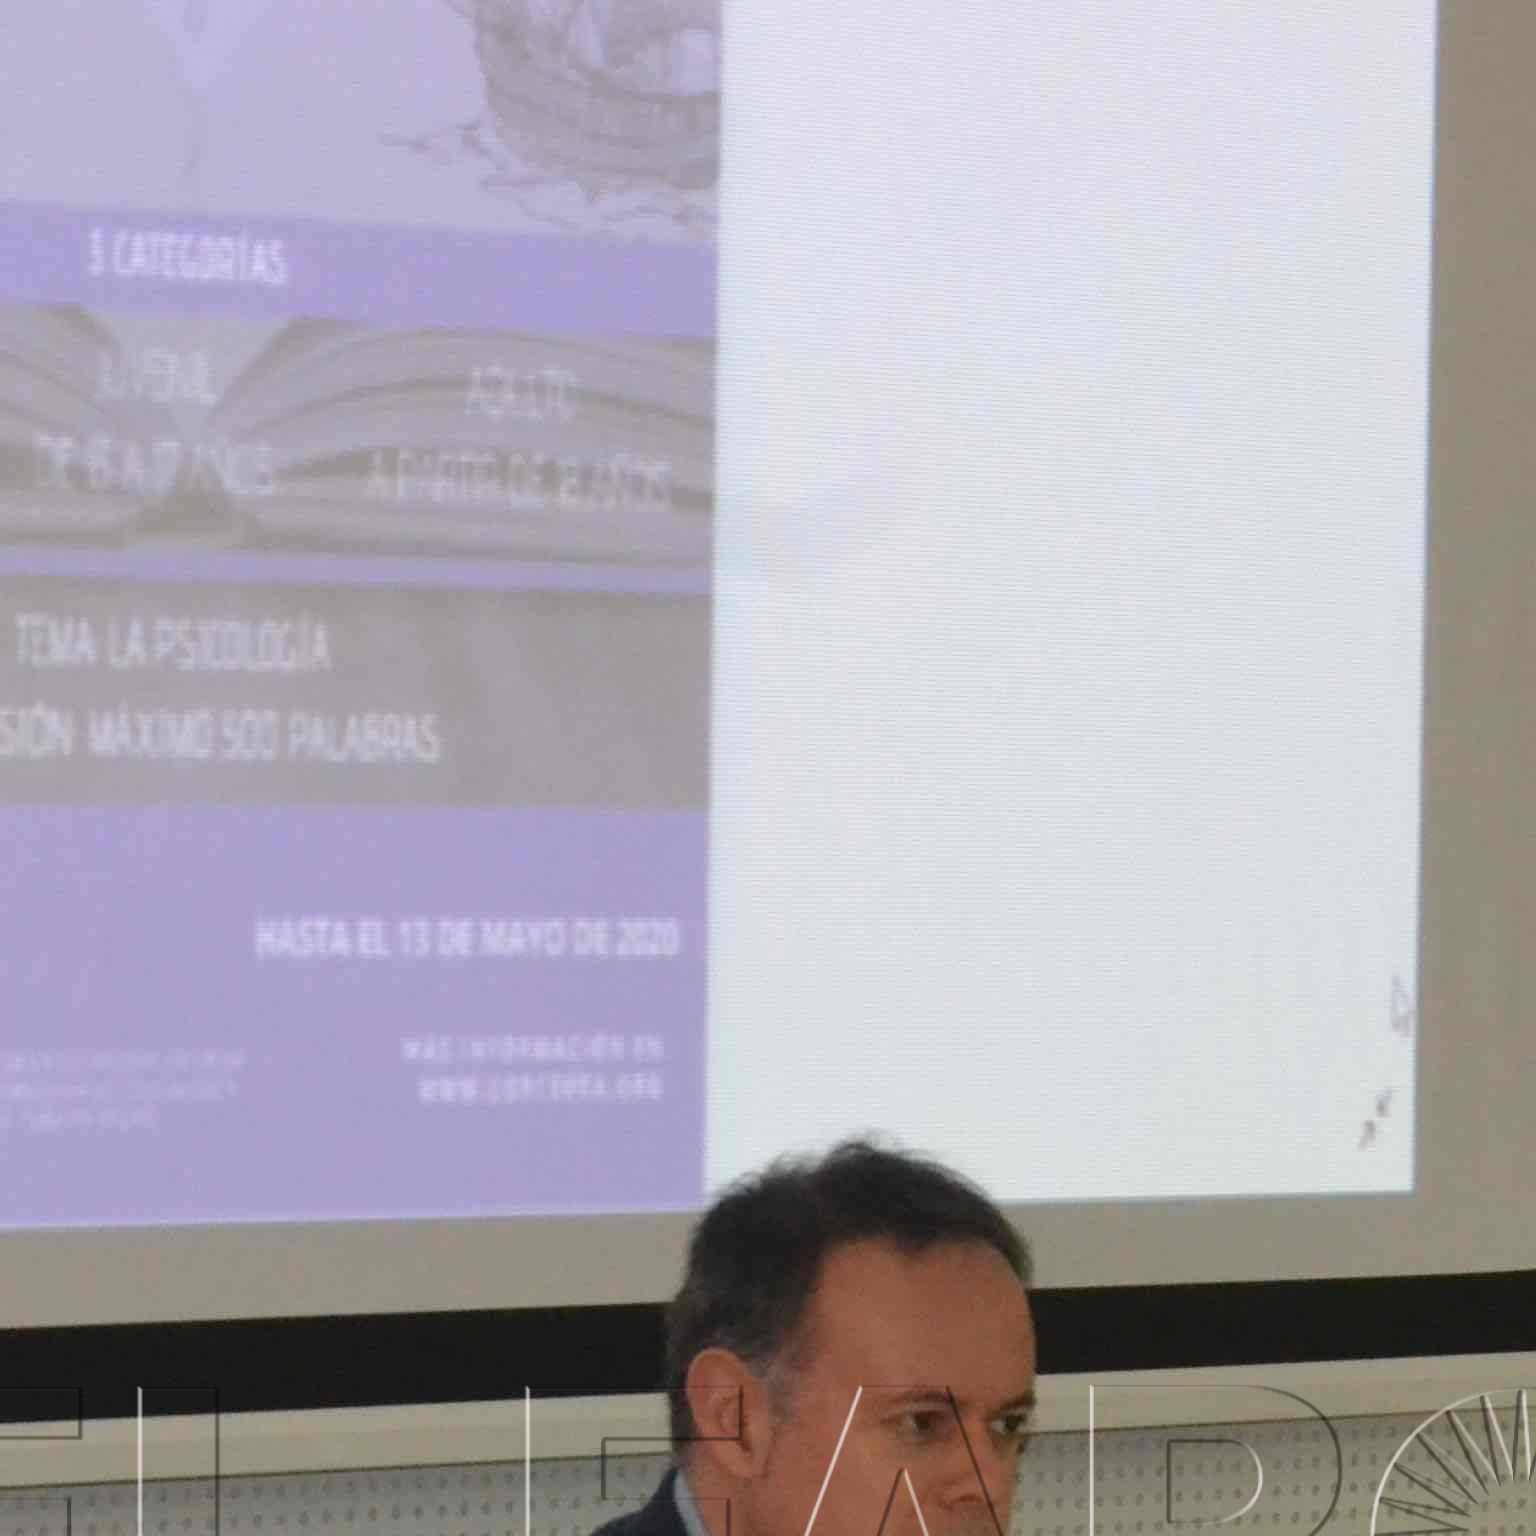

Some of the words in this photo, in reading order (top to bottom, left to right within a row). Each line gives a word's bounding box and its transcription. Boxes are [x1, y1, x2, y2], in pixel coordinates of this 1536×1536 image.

[109, 613, 148, 670] LA
[153, 608, 334, 673] PSICOLOGÍA
[87, 697, 216, 761] MÁXIMO
[287, 706, 442, 765] PALABRAS
[254, 915, 353, 960] HASTA
[357, 915, 392, 960] EL
[436, 915, 474, 960] DE
[478, 915, 566, 960] MAYO
[570, 915, 610, 960] DE
[615, 915, 681, 960] 2020
